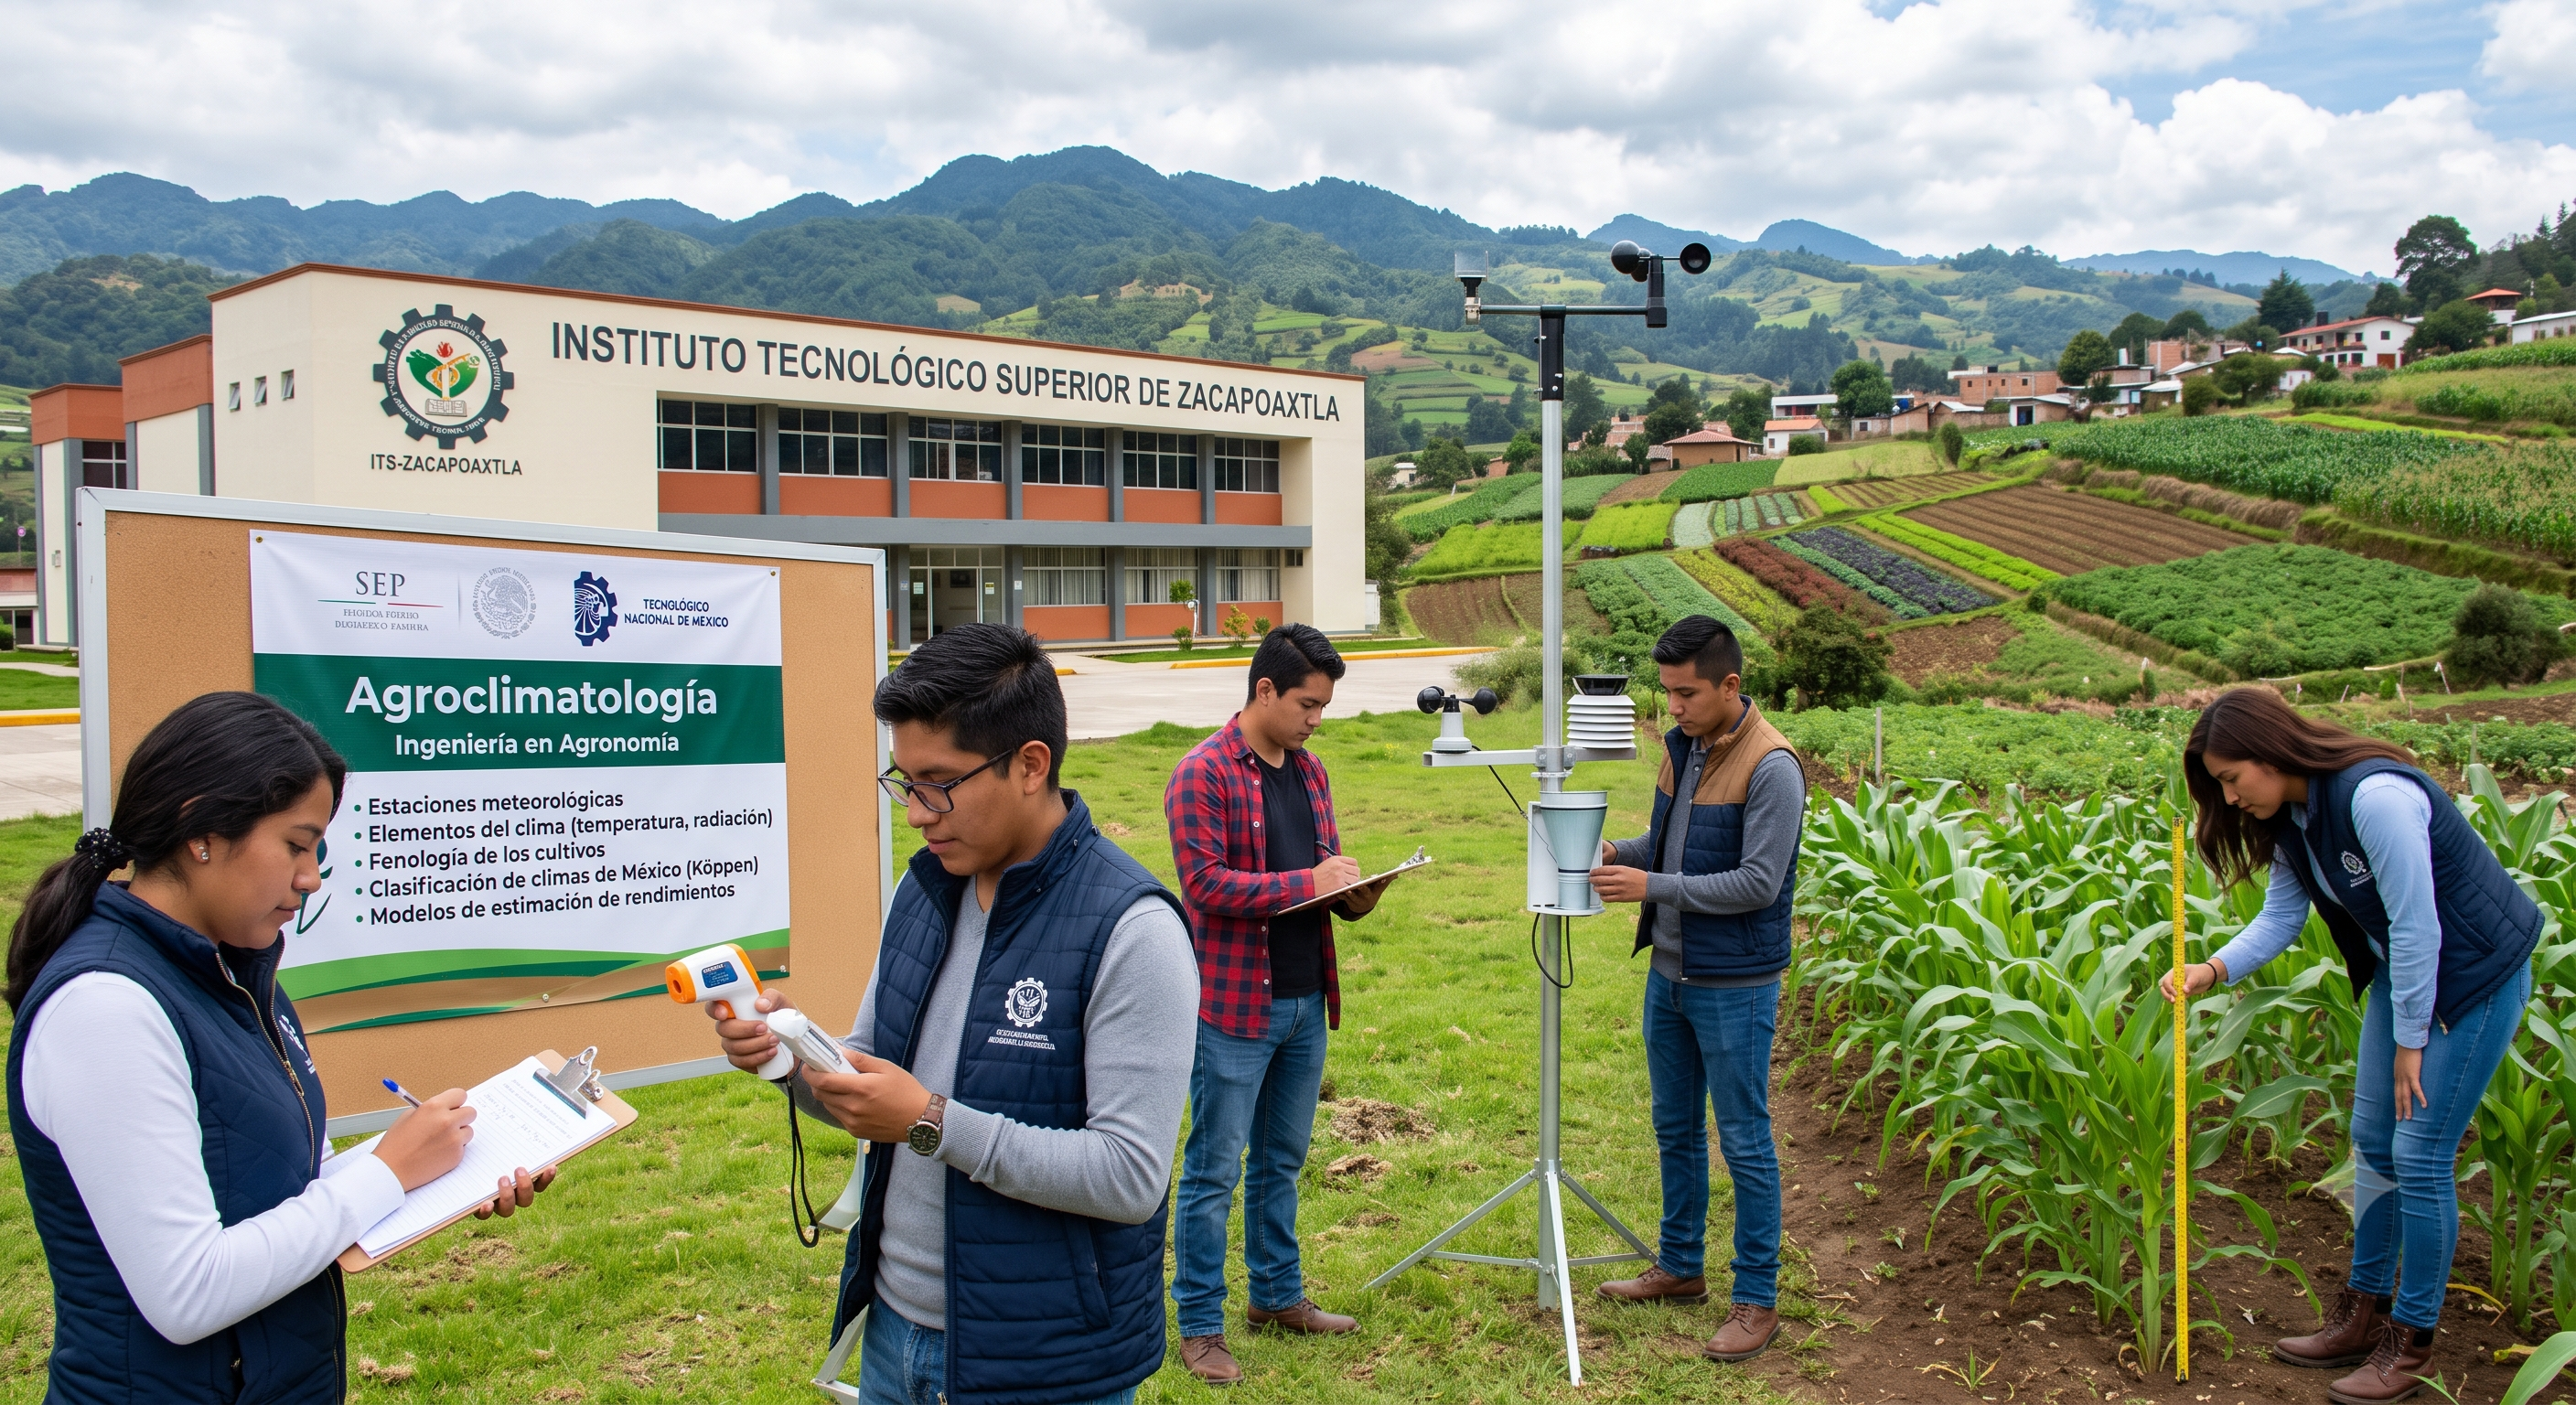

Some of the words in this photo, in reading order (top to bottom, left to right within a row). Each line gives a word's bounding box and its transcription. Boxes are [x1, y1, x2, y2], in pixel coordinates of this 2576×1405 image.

[553, 321, 746, 373] INSTITUTO
[757, 340, 987, 392] TECNOLÓGICO
[995, 363, 1132, 405] SUPERIOR
[1139, 377, 1170, 408] DE
[1177, 381, 1340, 422] ZACAPOAXTLA
[370, 453, 522, 476] ITS-ZACAPOAXTLA
[356, 571, 405, 597] SEP
[624, 613, 675, 626] NACIONAL
[677, 615, 690, 627] DE
[692, 616, 729, 627] MEXICO
[345, 674, 717, 724] Agroclimatología
[396, 732, 518, 761] Ingeniería
[524, 737, 553, 754] en
[558, 731, 680, 758] Agronomía
[369, 794, 477, 816] Estaciones
[482, 789, 624, 812] meteorológicas
[369, 823, 476, 843] Elementos
[480, 819, 510, 838] del
[515, 817, 565, 837] clima
[571, 815, 689, 839] (temperatura,
[693, 808, 773, 829] radiación)
[370, 848, 468, 872] Fenología
[474, 846, 498, 864] de
[503, 845, 530, 863] los
[534, 841, 606, 861] cultivos
[369, 873, 497, 898] Clasificación
[502, 871, 526, 889] de
[531, 868, 590, 887] climas
[595, 864, 617, 883] de
[622, 861, 682, 881] México
[686, 855, 758, 881] (Köppen)
[370, 903, 456, 926] Modelos
[461, 900, 486, 918] de
[491, 892, 593, 917] estimación
[598, 890, 620, 908] de
[625, 883, 735, 906] rendimientos
